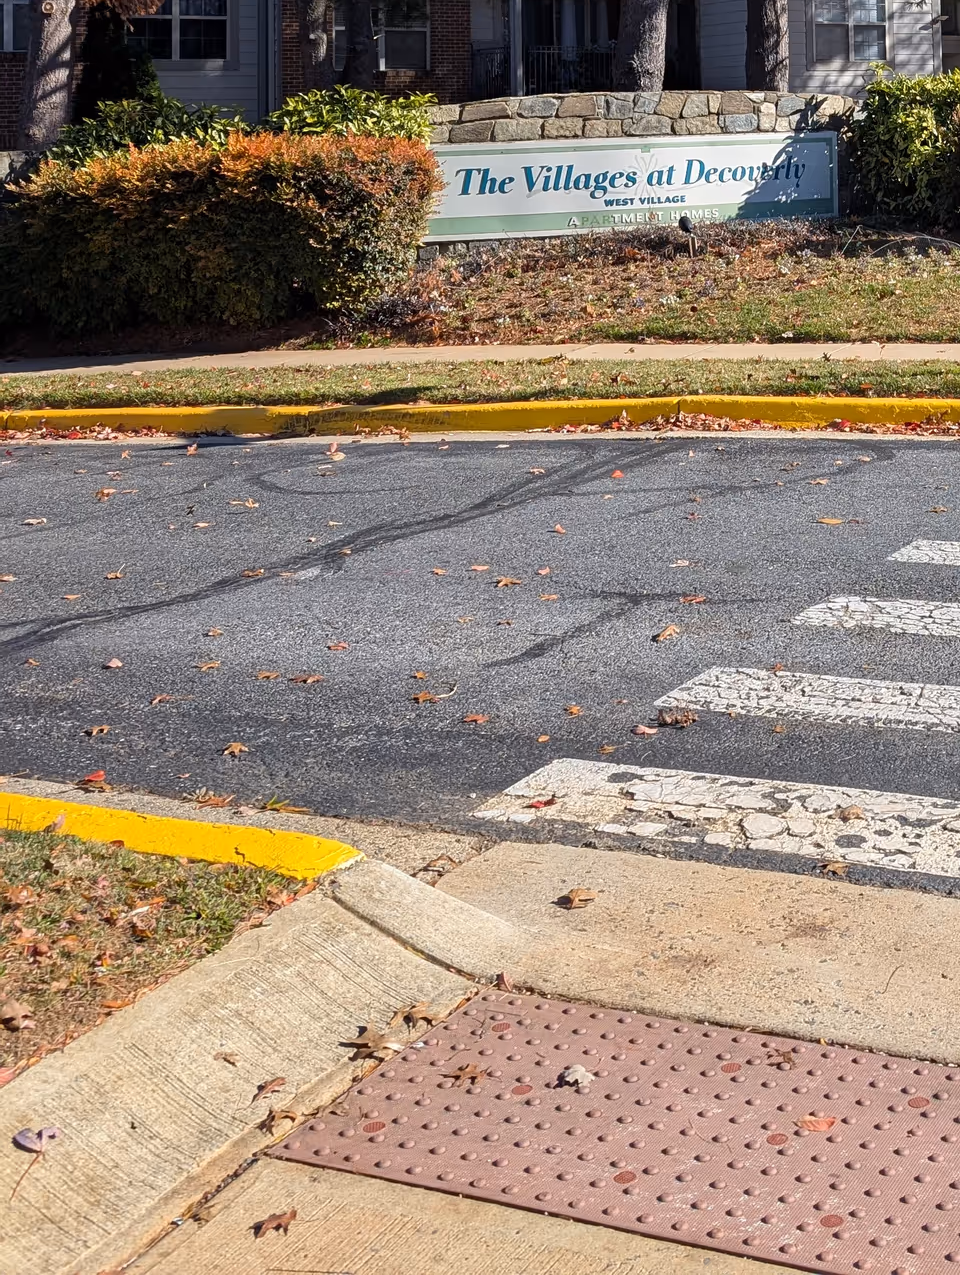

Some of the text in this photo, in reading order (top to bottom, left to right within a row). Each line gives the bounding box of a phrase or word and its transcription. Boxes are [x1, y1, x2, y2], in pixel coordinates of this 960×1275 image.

[455, 155, 806, 200] The Villages at Decoverly
[604, 194, 686, 207] WEST VILLAGE
[567, 208, 719, 227] APARTMENT HOMES
